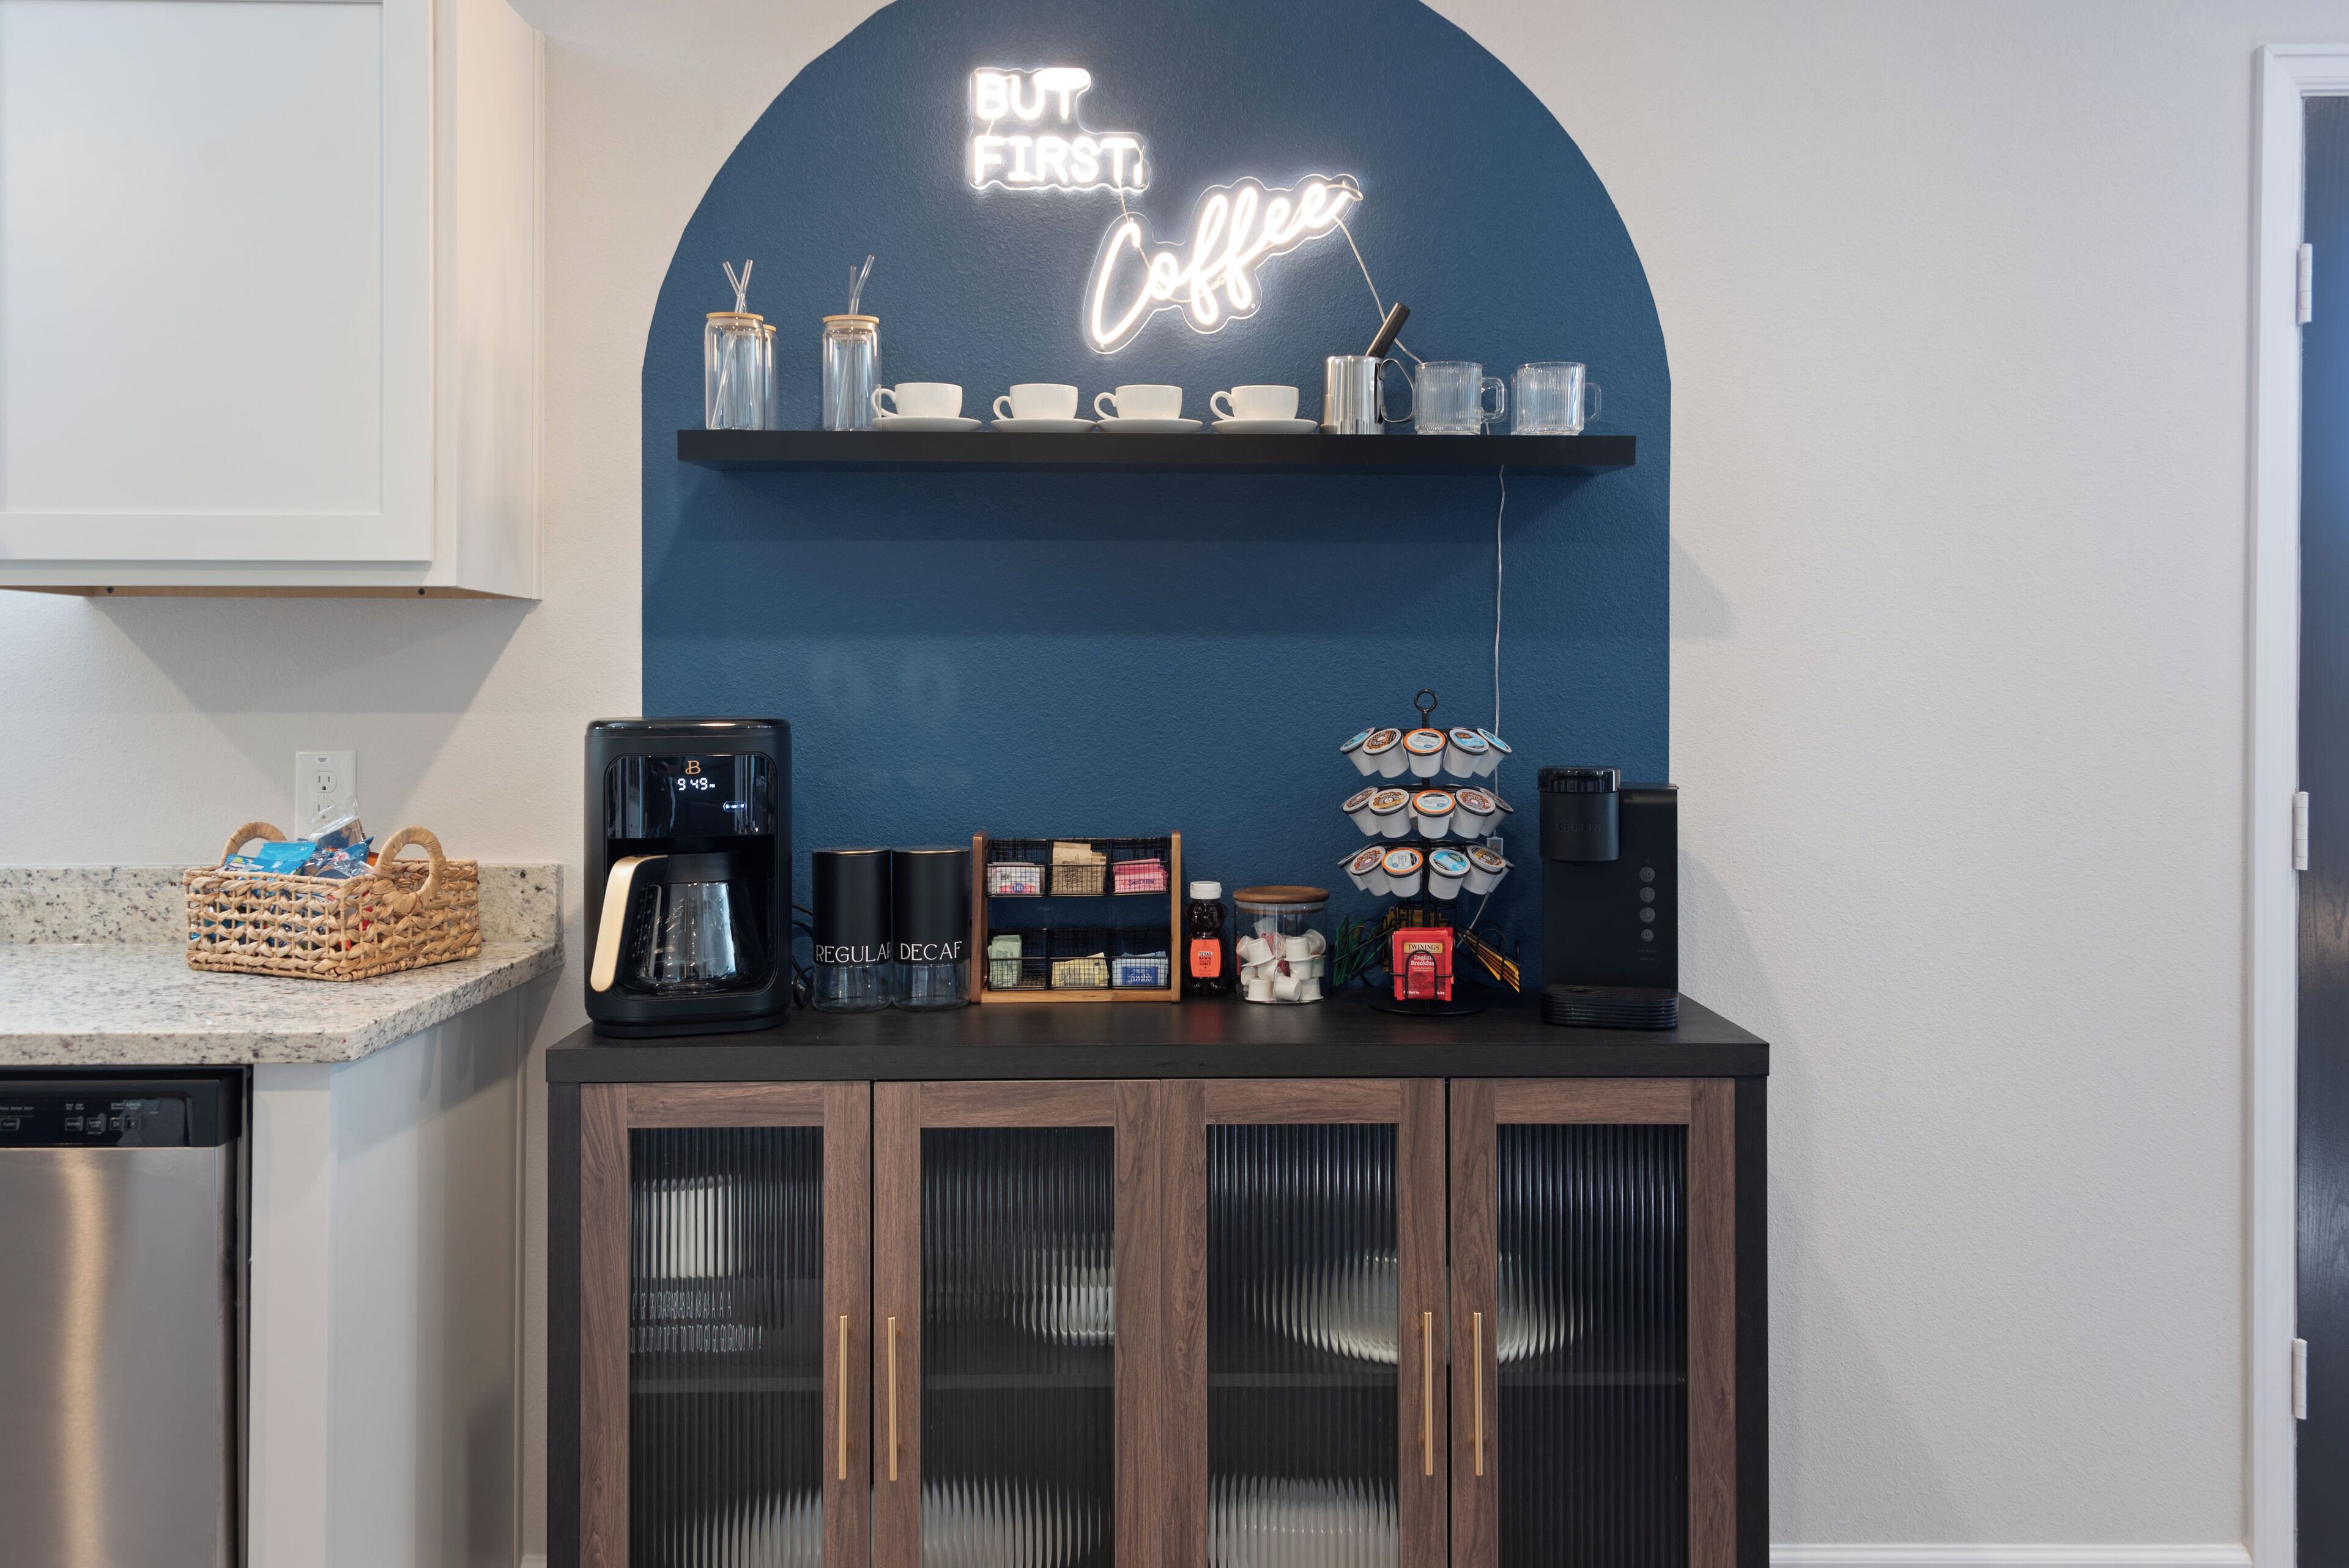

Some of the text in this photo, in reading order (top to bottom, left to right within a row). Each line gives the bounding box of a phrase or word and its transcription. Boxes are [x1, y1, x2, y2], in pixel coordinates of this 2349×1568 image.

[974, 70, 1090, 120] BUT
[1092, 182, 1354, 344] Coffee
[900, 941, 962, 960] DECAF
